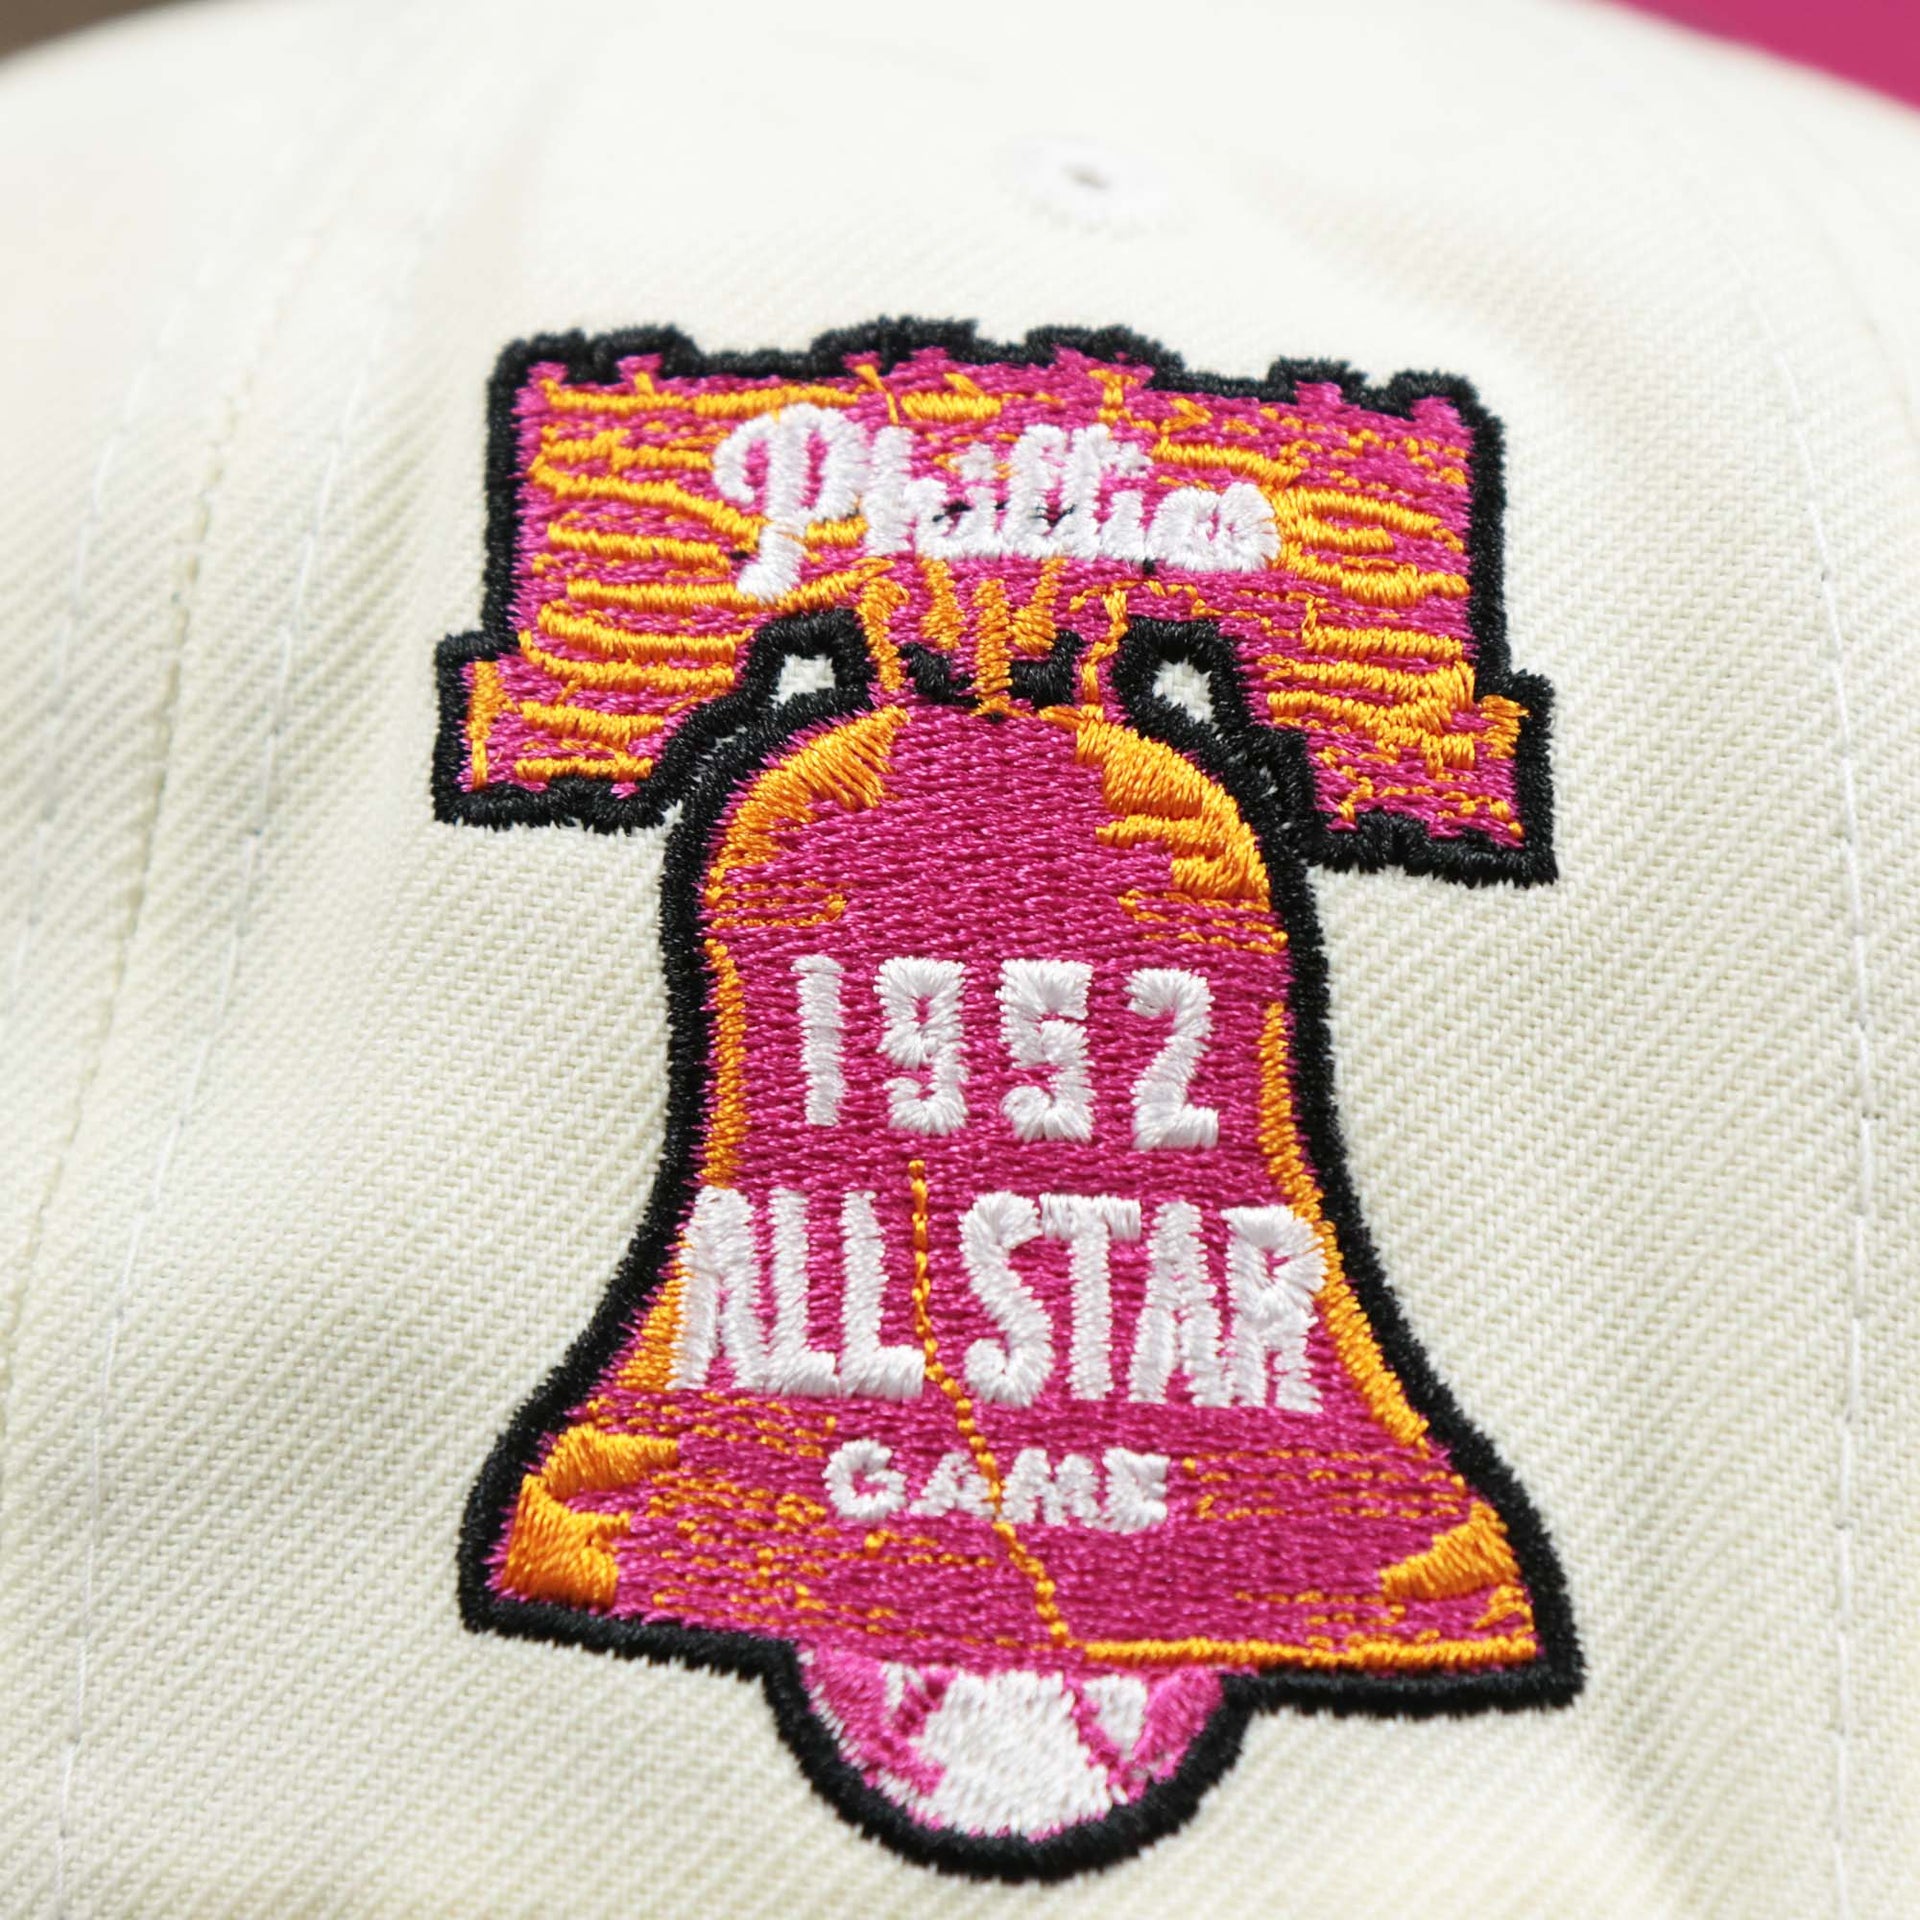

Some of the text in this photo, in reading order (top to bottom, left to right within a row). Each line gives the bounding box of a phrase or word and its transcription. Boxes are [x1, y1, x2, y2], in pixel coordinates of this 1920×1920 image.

[790, 954, 1219, 1151] 1952
[665, 1185, 1327, 1414] ALL STAR
[823, 1438, 1171, 1535] GAME
